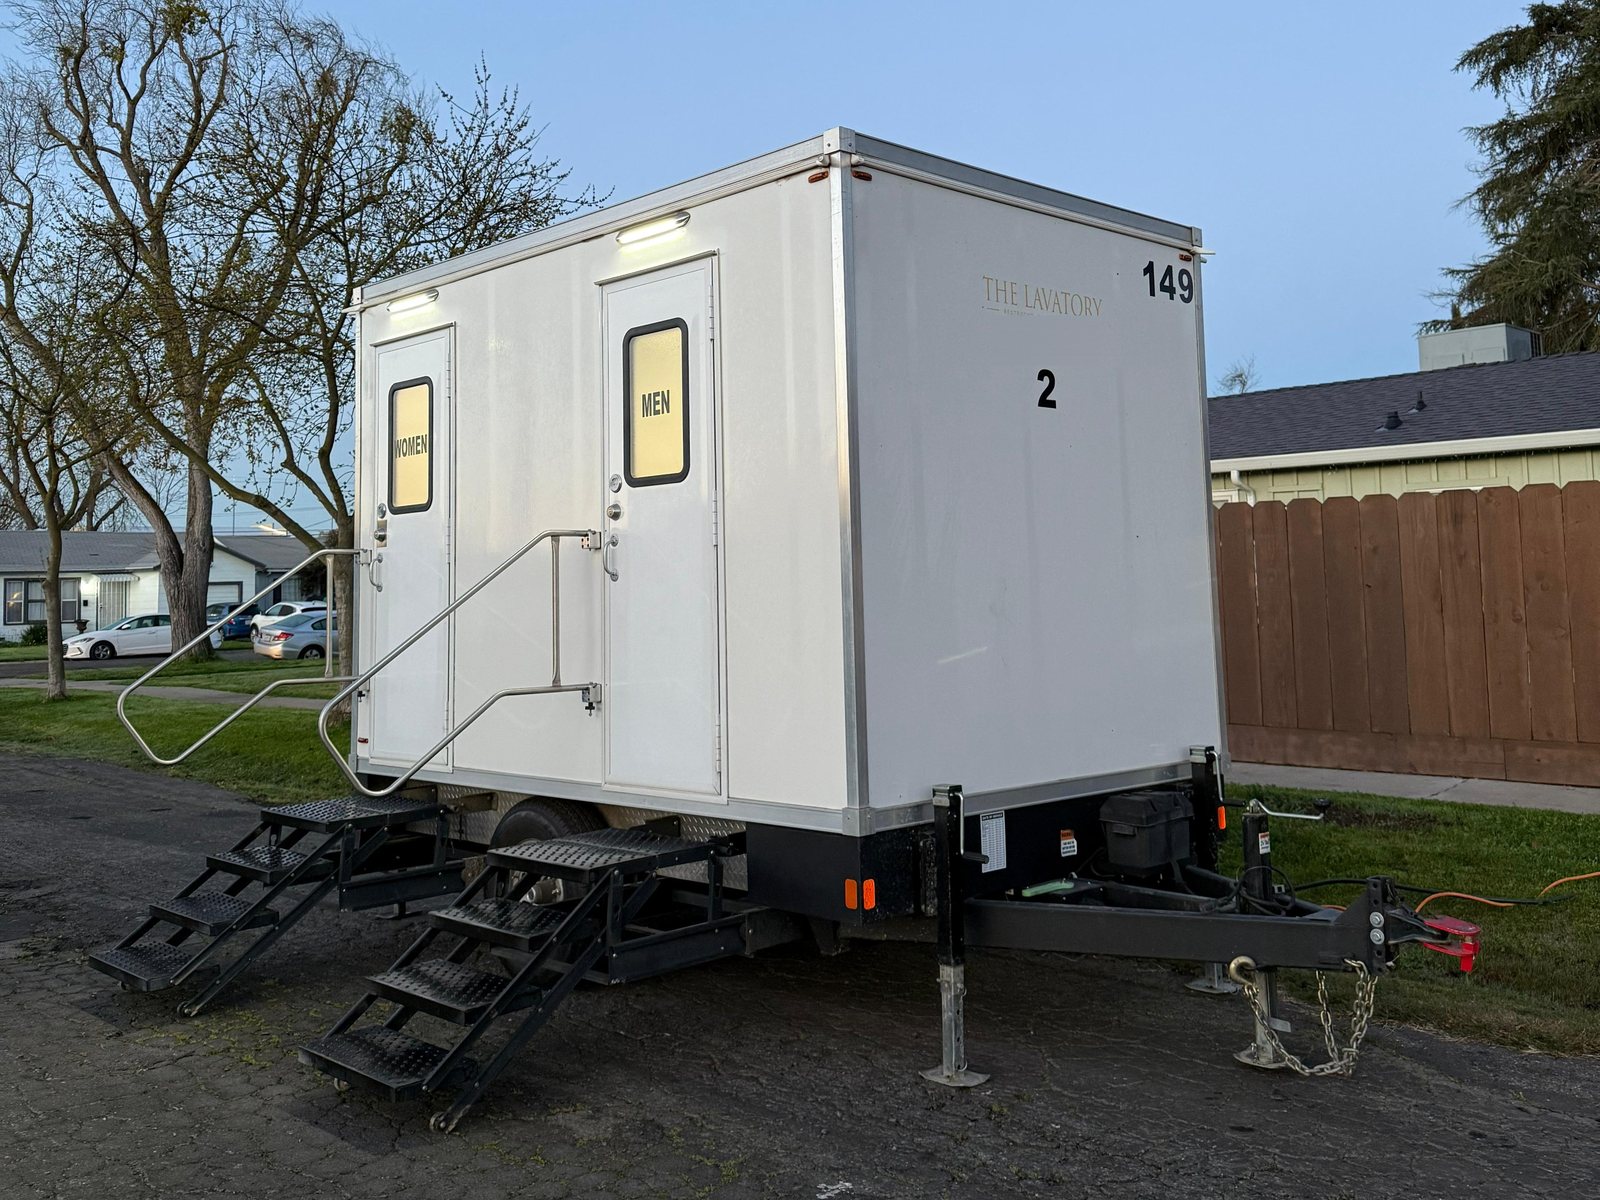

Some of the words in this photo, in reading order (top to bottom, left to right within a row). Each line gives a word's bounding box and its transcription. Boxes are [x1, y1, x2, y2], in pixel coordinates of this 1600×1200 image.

[983, 276, 1017, 306] THE
[1024, 284, 1102, 317] LAVATORY
[1143, 261, 1193, 303] 149
[642, 390, 670, 418] MEN
[1037, 369, 1056, 409] 2
[394, 434, 427, 459] WOMEN
